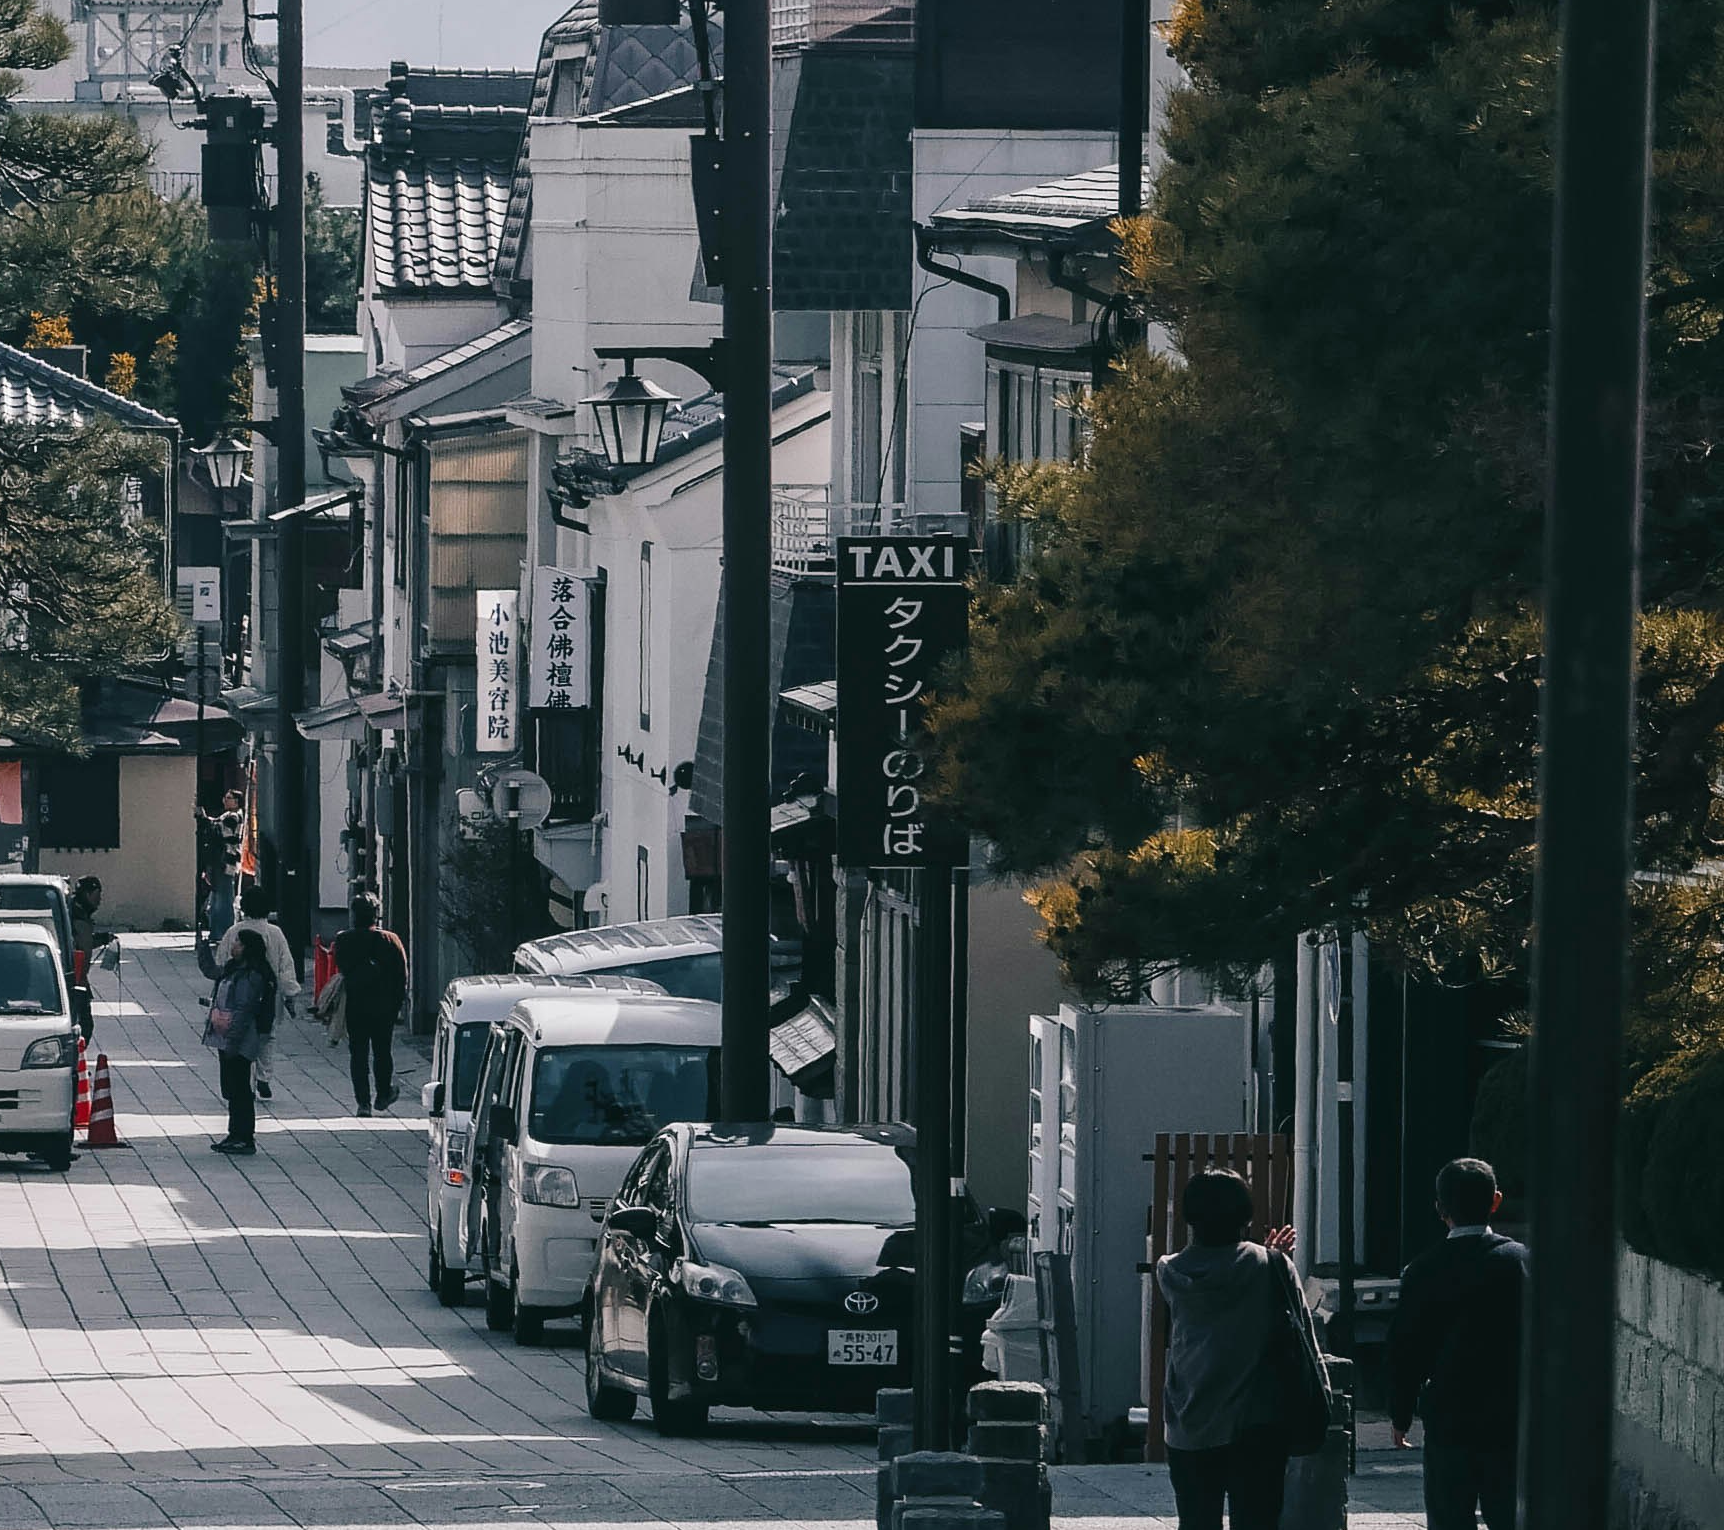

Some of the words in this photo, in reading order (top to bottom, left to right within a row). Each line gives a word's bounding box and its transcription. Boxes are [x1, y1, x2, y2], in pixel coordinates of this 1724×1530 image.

[848, 546, 954, 578] TAXI
[487, 603, 510, 739] 小池美容院
[882, 596, 925, 855] タクシーのりば
[843, 1344, 894, 1363] 55-47
